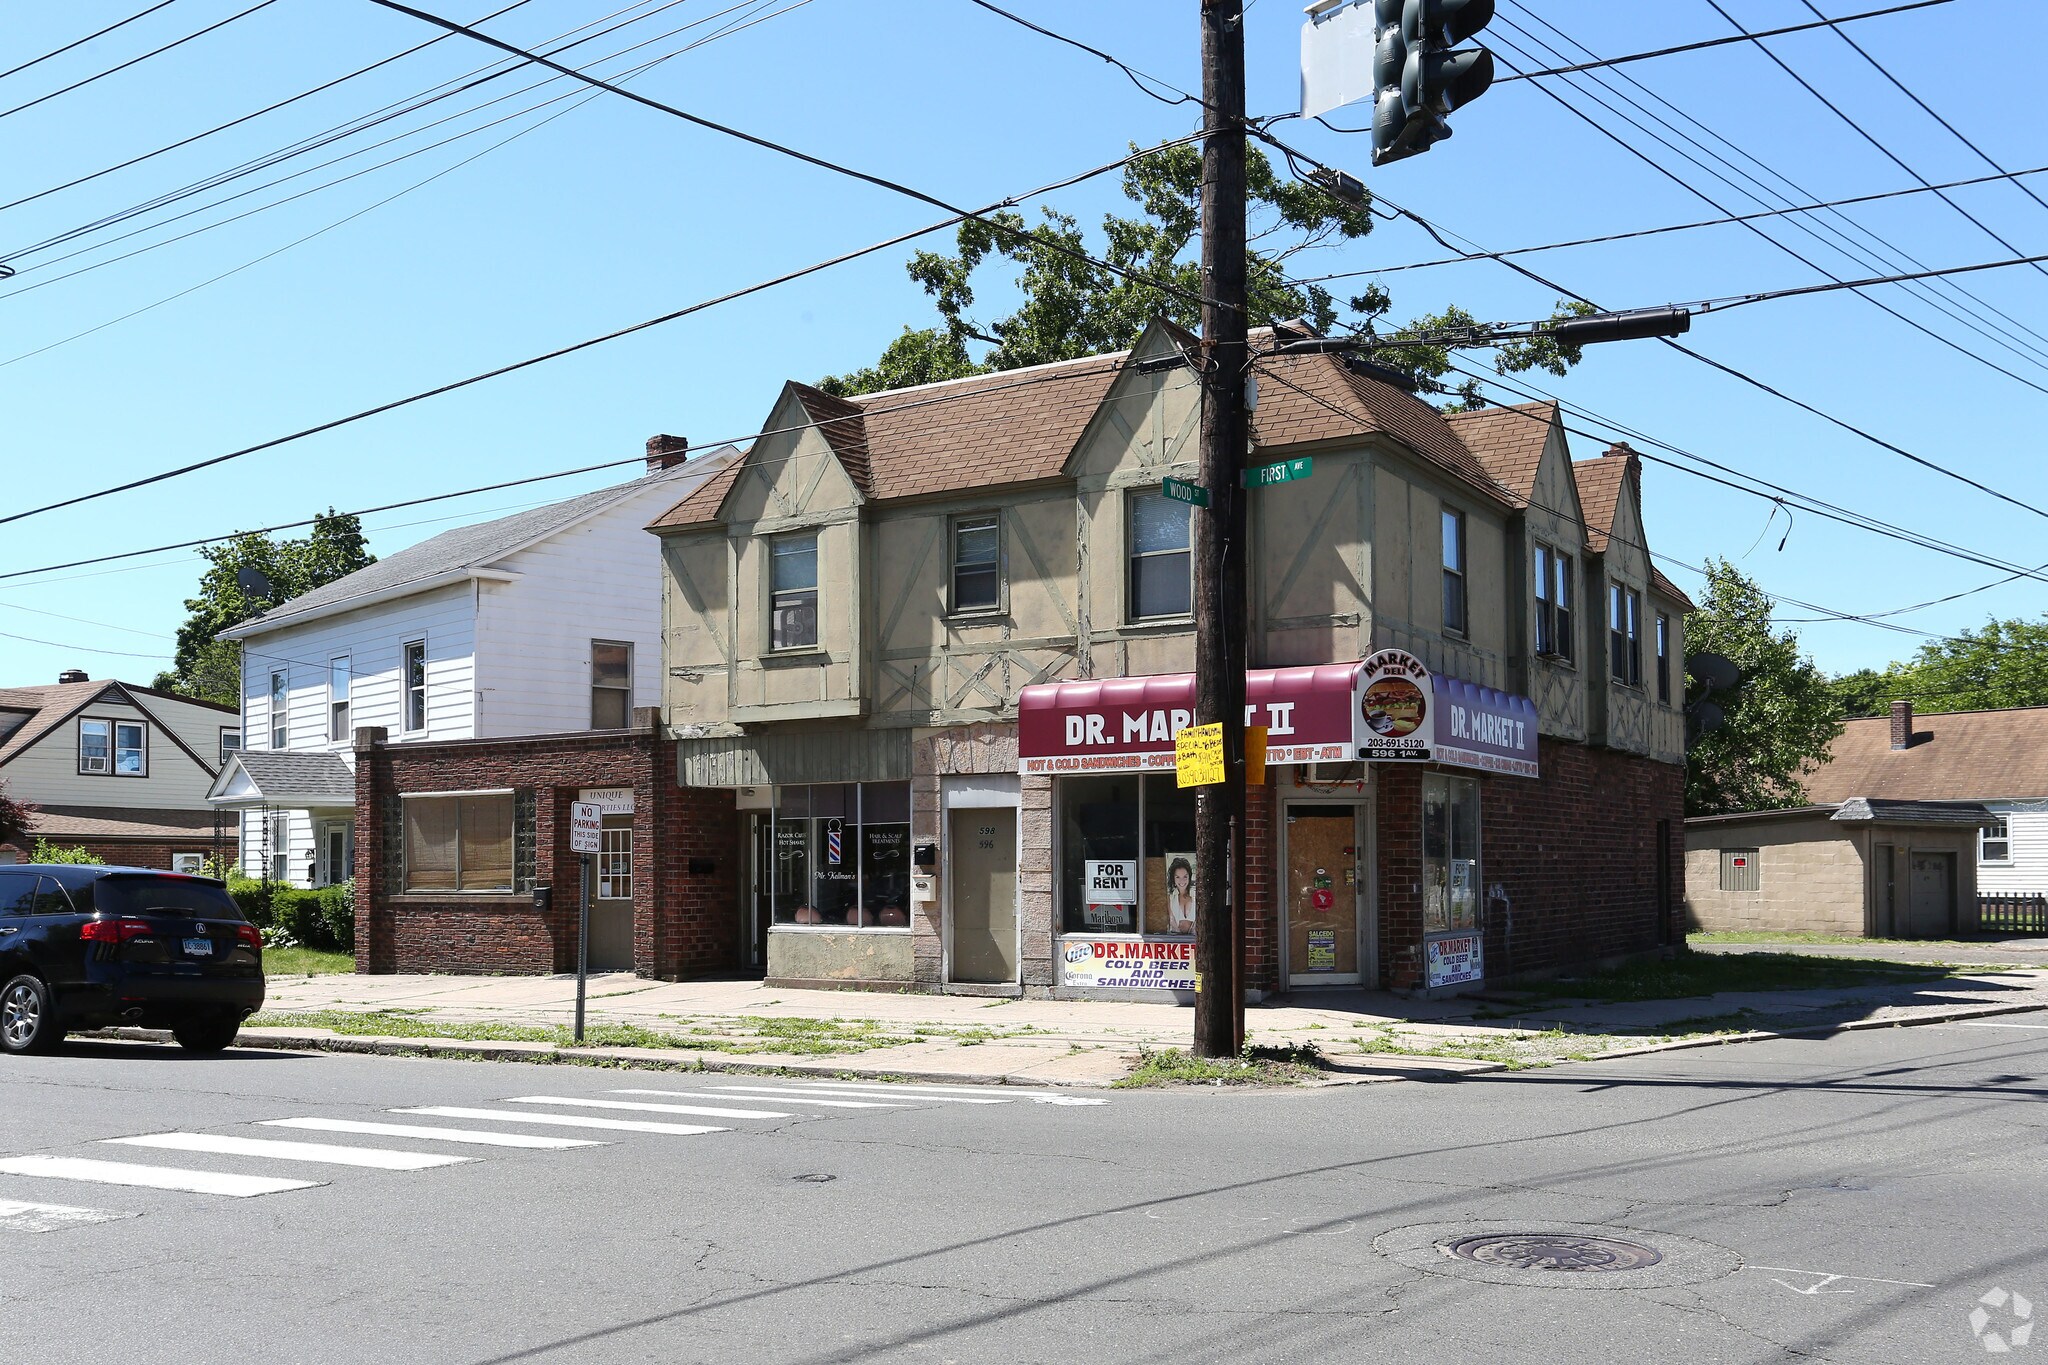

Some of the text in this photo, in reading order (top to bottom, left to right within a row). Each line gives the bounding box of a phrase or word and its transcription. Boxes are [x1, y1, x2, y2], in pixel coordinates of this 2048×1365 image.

[1261, 460, 1304, 483] FIRST AVE
[1170, 481, 1200, 501] WOOD ST
[1363, 652, 1427, 679] MARKET
[1383, 667, 1406, 675] DELI
[1065, 713, 1115, 746] DR.
[1266, 701, 1295, 736] II
[1450, 704, 1525, 751] DR. MARKET II
[1367, 739, 1424, 748] 203-691-5120
[1293, 747, 1315, 761] EBT
[1319, 745, 1343, 760] ATM
[1027, 758, 1046, 772] HOT
[1046, 758, 1054, 770] &
[1054, 757, 1080, 770] COLD
[1081, 754, 1142, 769] SANDWICHES
[590, 791, 623, 801] UNIQUE
[581, 807, 593, 817] NO
[622, 803, 635, 811] LLC
[574, 819, 599, 830] PARKING
[586, 831, 599, 839] SIDE
[979, 827, 996, 835] 598
[979, 840, 994, 849] 596
[1097, 864, 1124, 876] FOR
[814, 871, 827, 880] Mr.
[1093, 877, 1128, 889] RENT
[1090, 910, 1124, 925] Marlboro
[1308, 930, 1335, 938] SALCEDO
[1105, 960, 1190, 970] COLD BEER
[1443, 954, 1469, 966] COLD BEER
[1451, 963, 1461, 973] AND
[1065, 971, 1093, 981] Corona
[1130, 969, 1164, 979] AND
[1441, 971, 1472, 984] SANDWICHES
[1096, 977, 1197, 988] SANDWICHES
